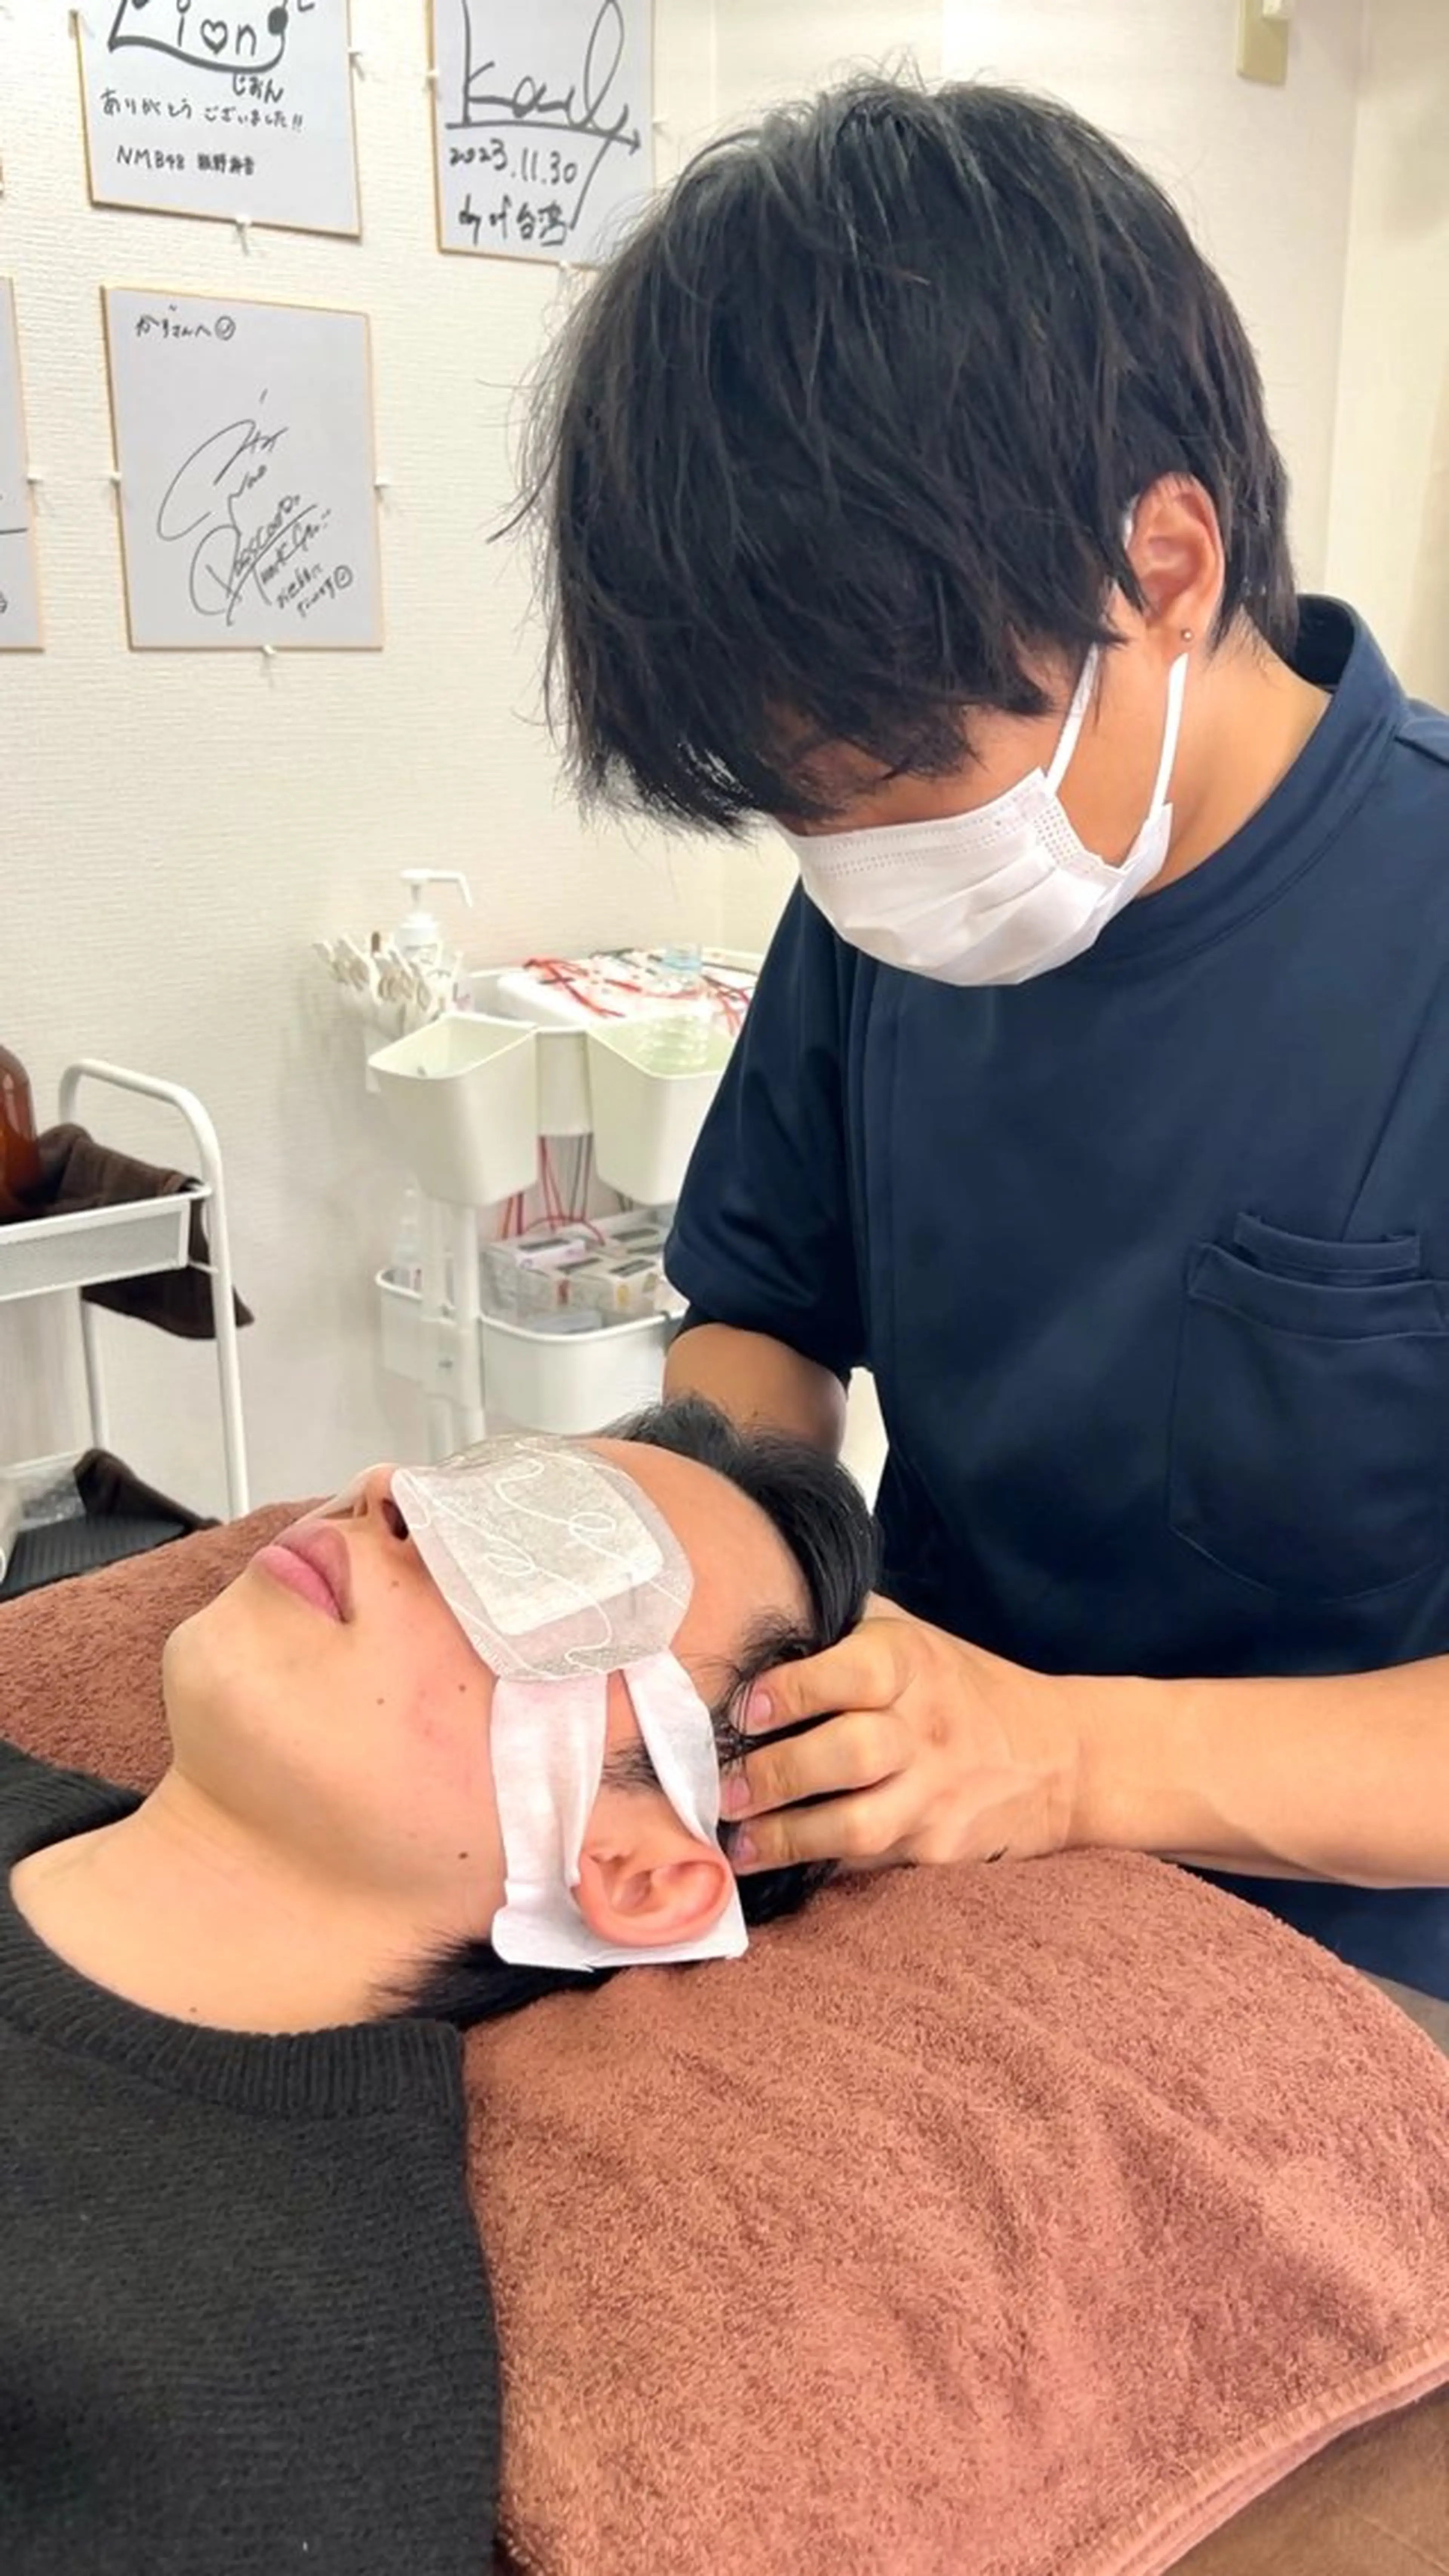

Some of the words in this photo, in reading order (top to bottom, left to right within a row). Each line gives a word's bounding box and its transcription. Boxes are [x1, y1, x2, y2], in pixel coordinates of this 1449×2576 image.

[100, 88, 192, 119] ありがとう
[117, 145, 185, 170] NMB48
